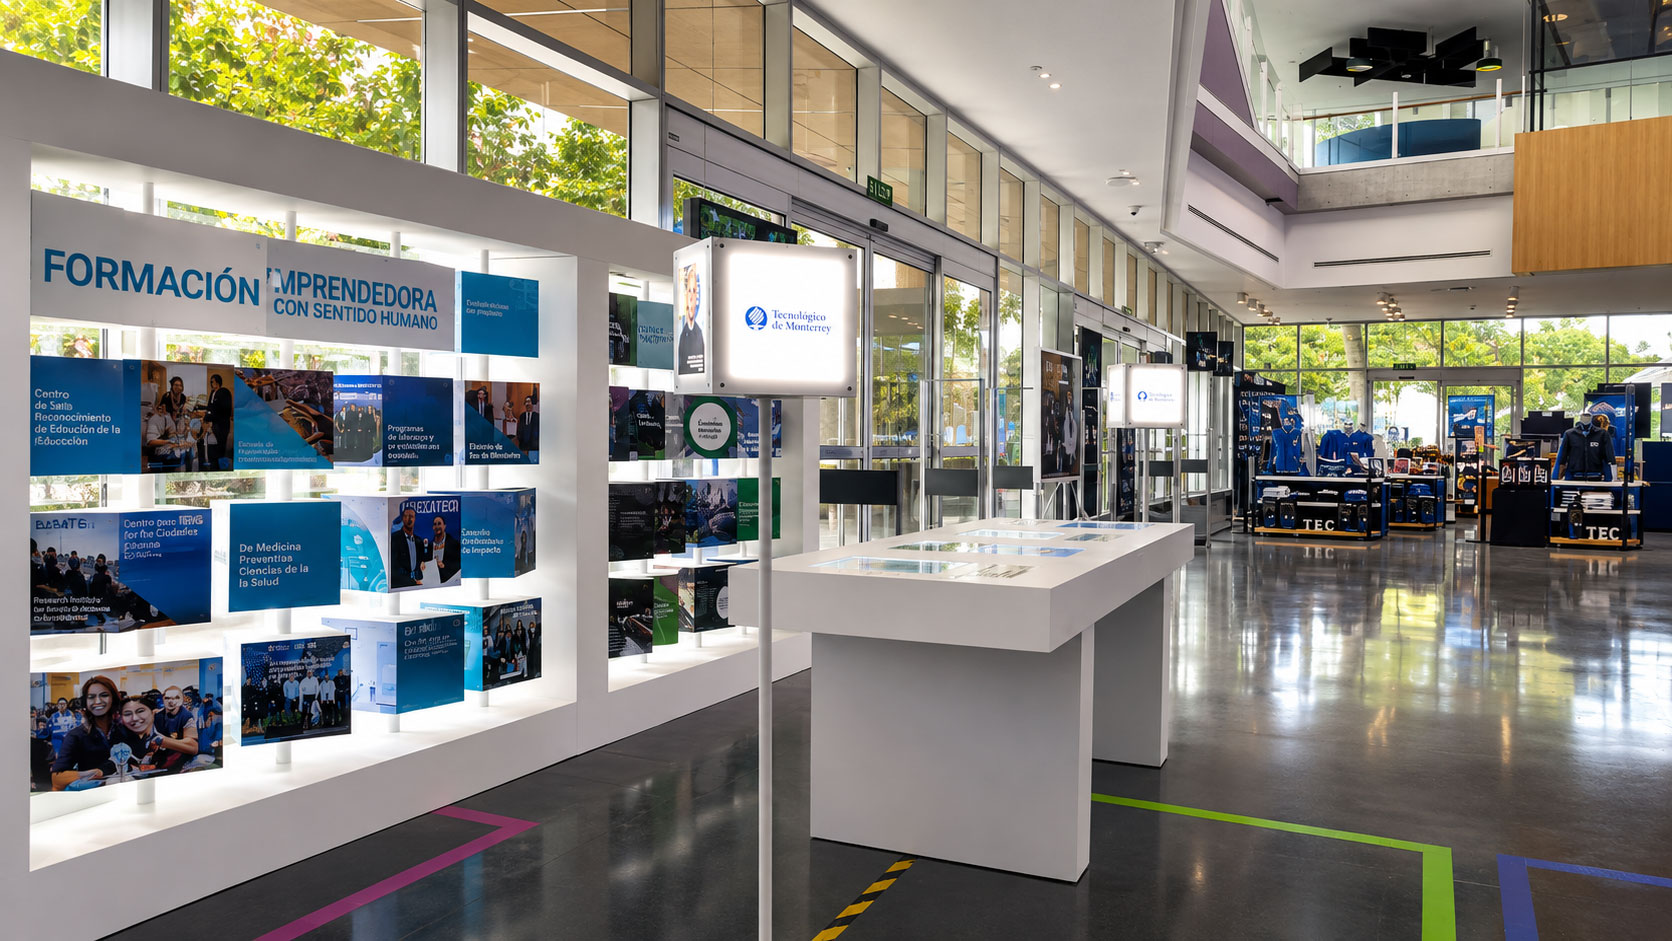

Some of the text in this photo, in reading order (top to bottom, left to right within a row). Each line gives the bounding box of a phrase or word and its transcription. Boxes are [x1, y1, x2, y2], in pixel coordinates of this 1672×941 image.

[44, 247, 260, 306] FORMACIÓN
[273, 297, 438, 330] CON SENTIDO HUMANO
[771, 309, 826, 323] Tecnológico
[771, 320, 832, 335] de Monterrey
[34, 424, 47, 433] de
[96, 424, 109, 434] de
[112, 424, 121, 434] la
[1302, 519, 1335, 531] TEC
[1585, 525, 1620, 540] TEC
[239, 542, 301, 553] De Medicina
[284, 564, 298, 574] de
[300, 563, 309, 573] la
[239, 578, 248, 588] la
